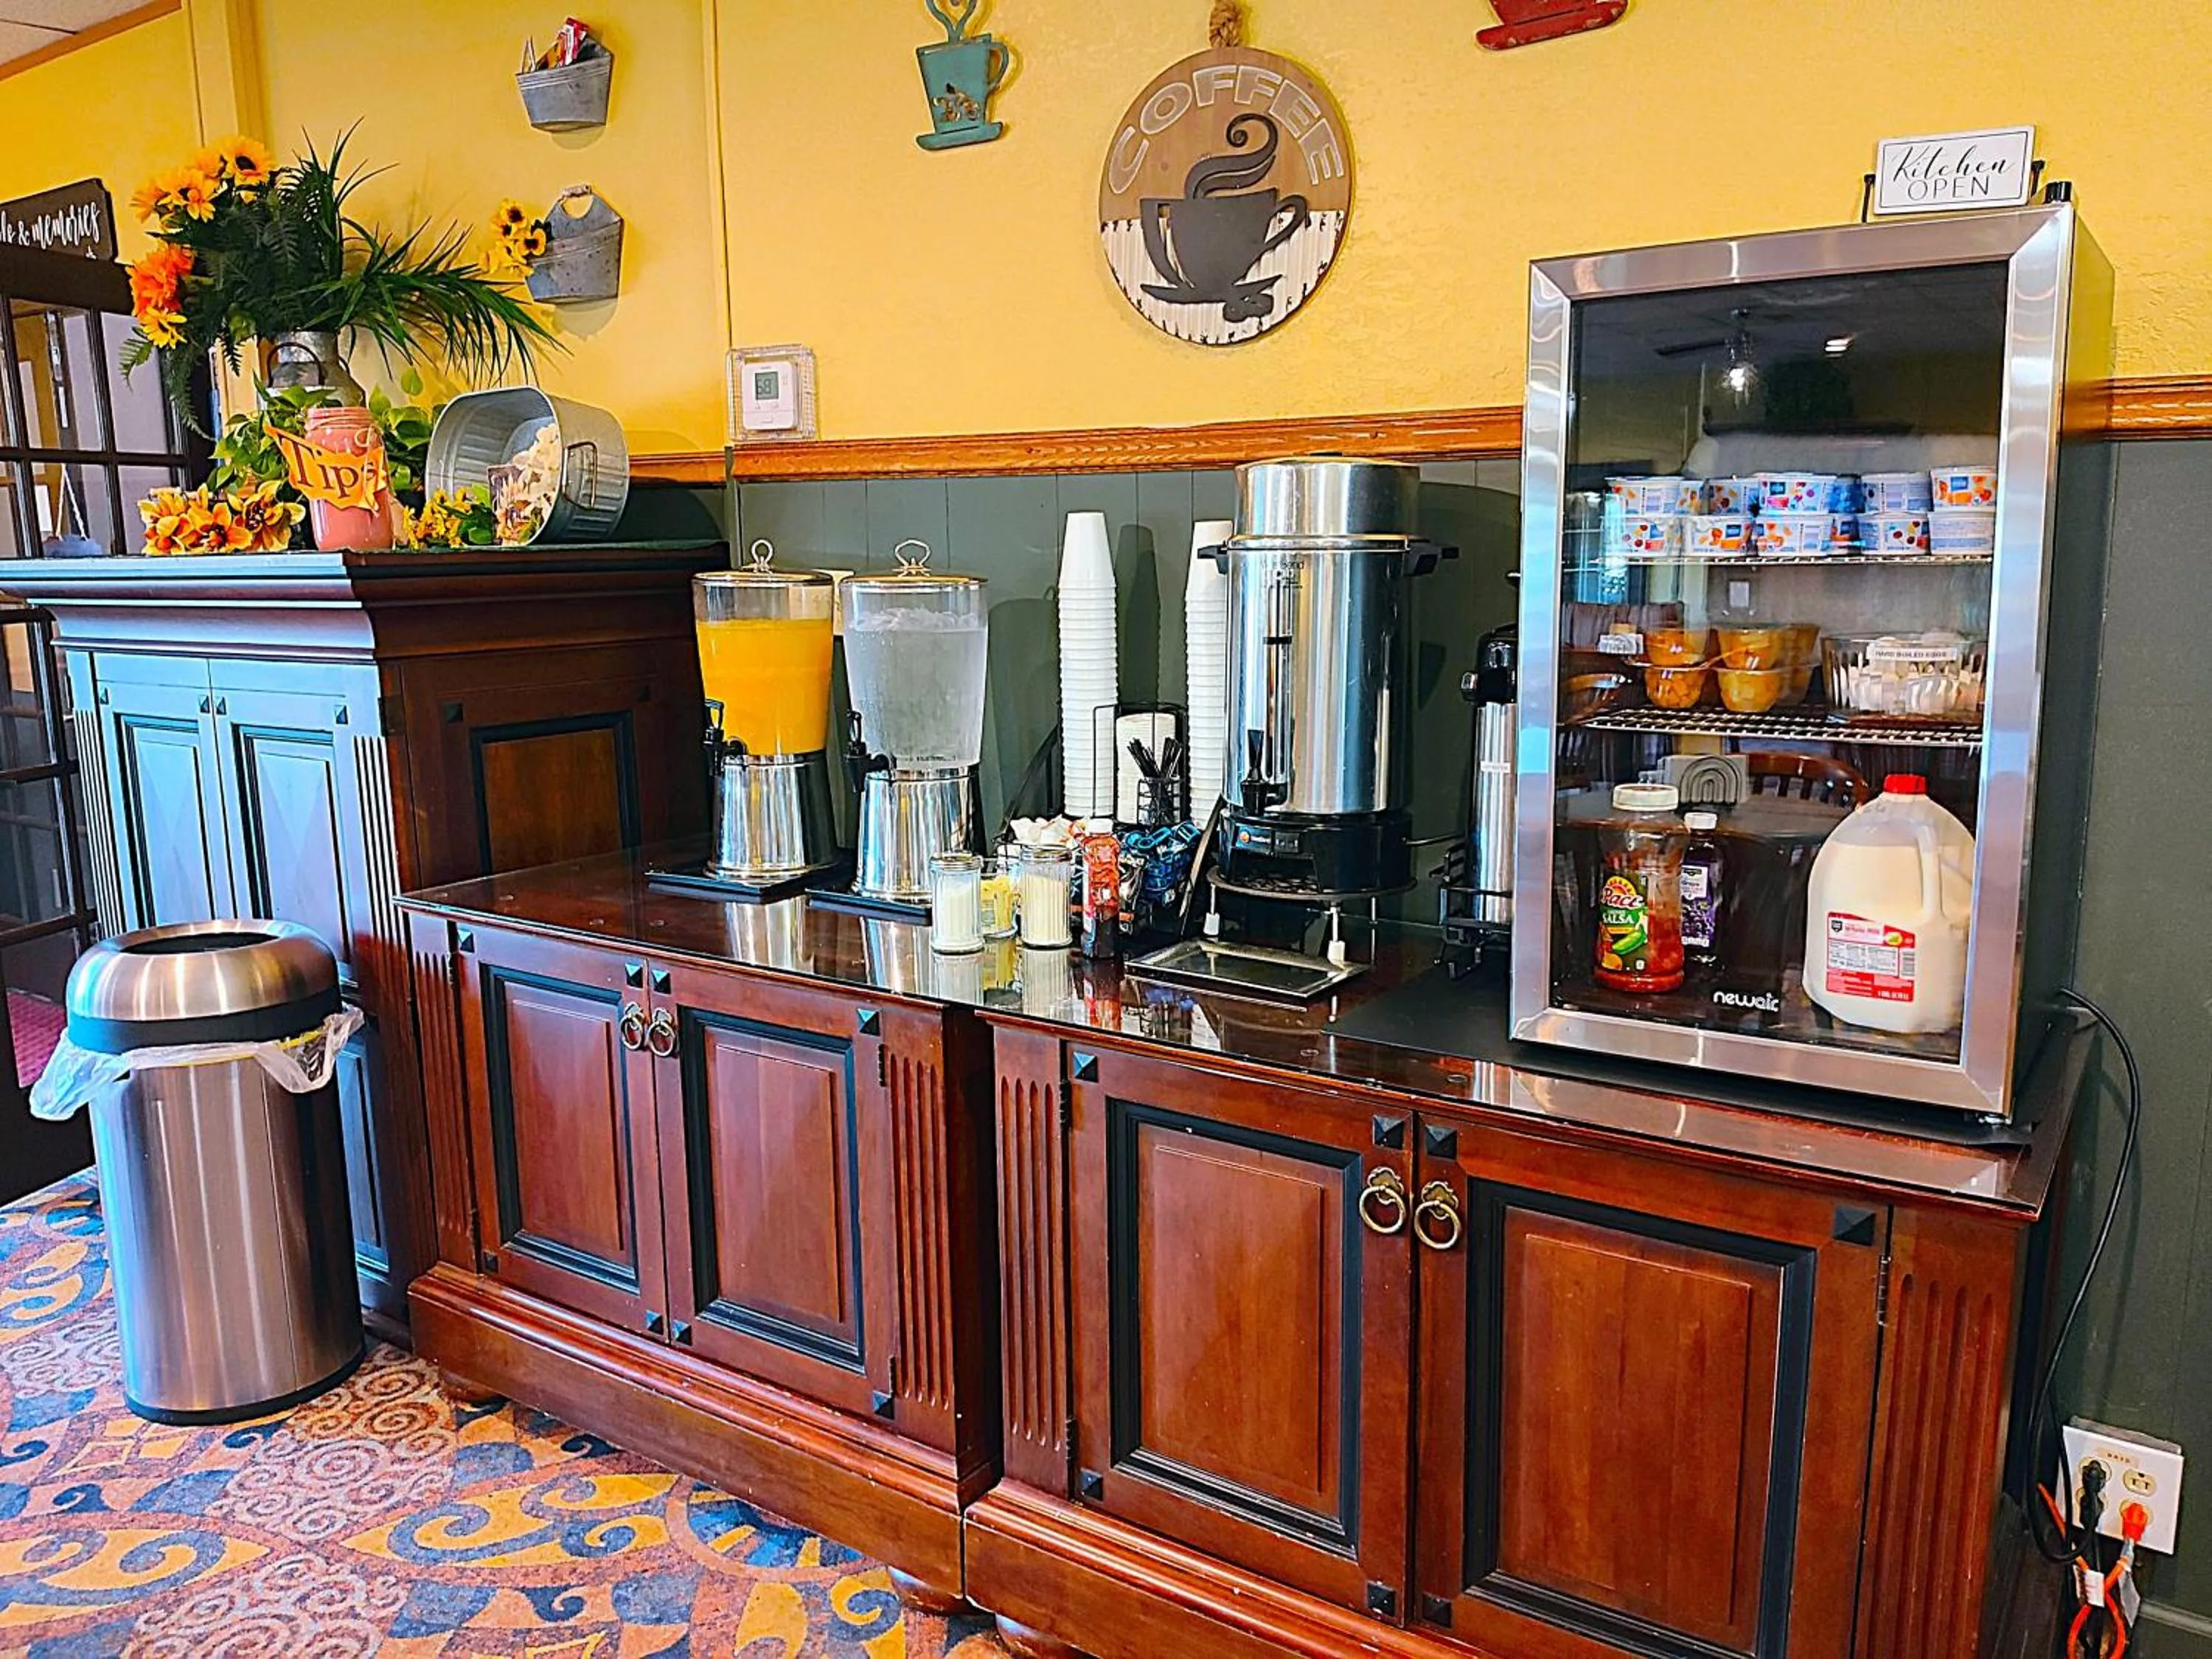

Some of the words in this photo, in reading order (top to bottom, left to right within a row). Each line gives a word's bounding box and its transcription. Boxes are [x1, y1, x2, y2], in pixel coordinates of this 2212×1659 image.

[1108, 64, 1344, 194] COFFEE
[1892, 145, 2015, 182] Kitchen
[1907, 175, 1990, 201] OPEN
[18, 220, 30, 246] &
[32, 201, 100, 250] memories
[276, 433, 378, 499] Tips
[1713, 990, 1779, 1013] newair
